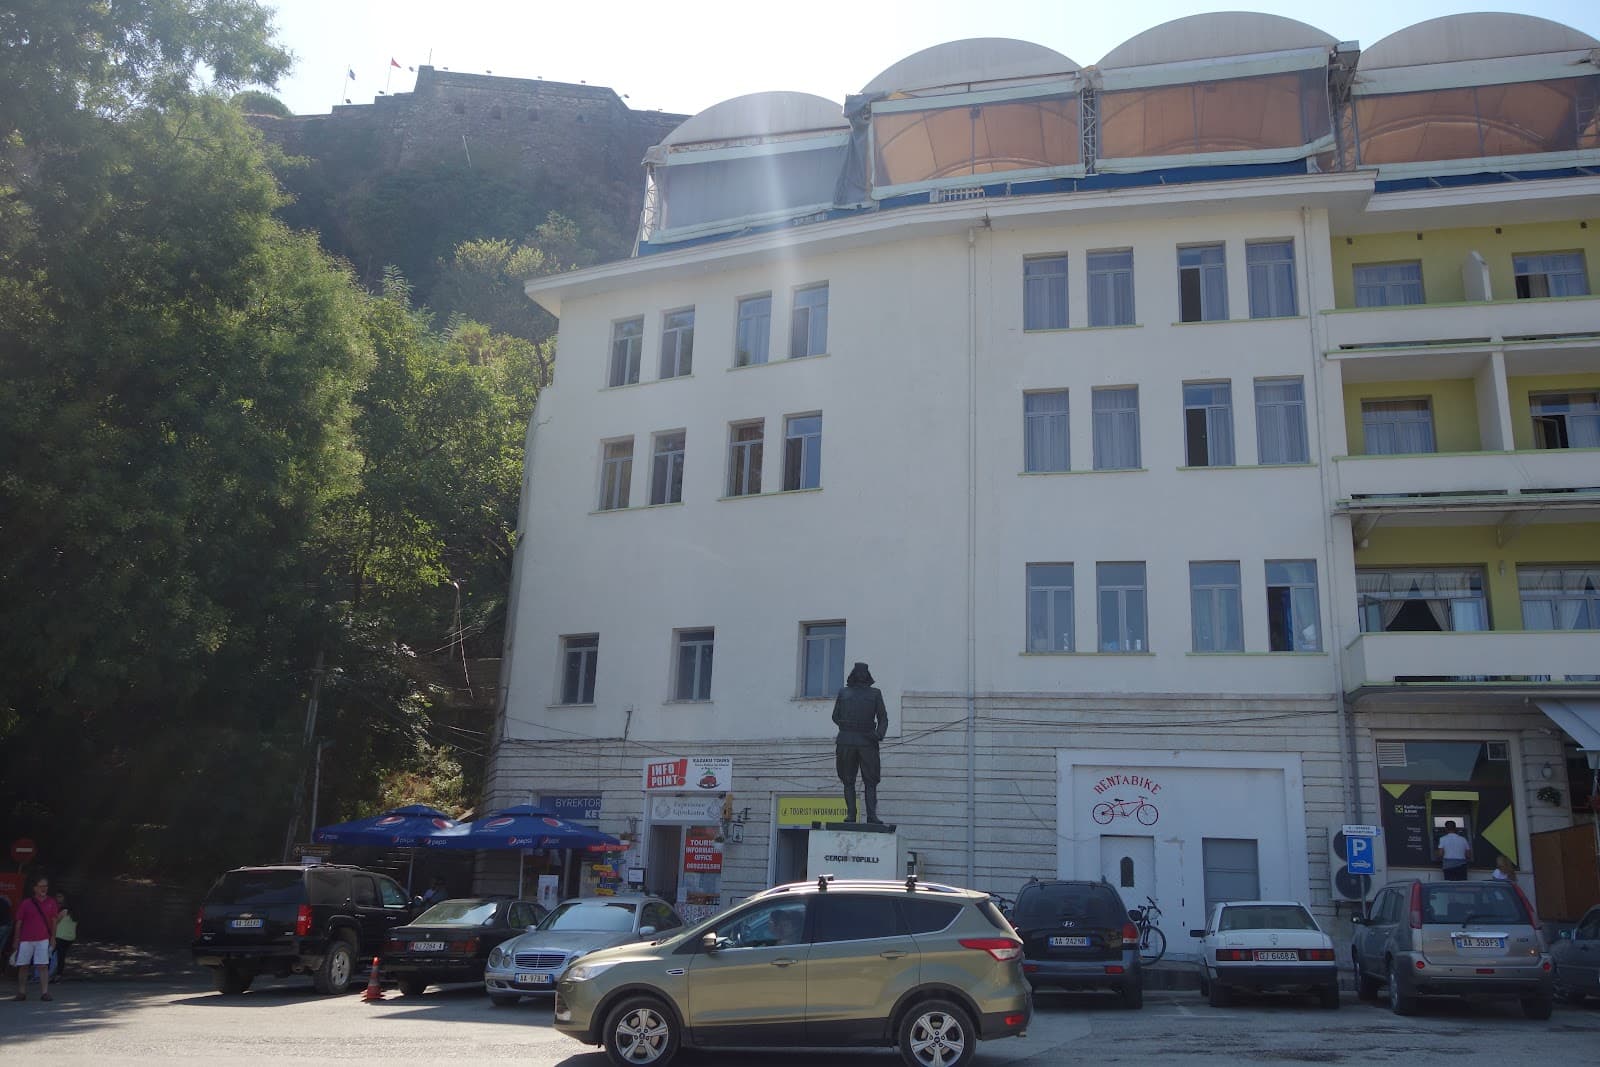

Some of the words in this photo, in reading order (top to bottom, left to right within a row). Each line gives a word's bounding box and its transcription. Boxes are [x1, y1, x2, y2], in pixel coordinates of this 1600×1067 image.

[651, 763, 675, 776] INFO
[790, 807, 812, 817] TOURIST
[1353, 839, 1367, 856] P
[1055, 937, 1063, 945] AA
[1463, 938, 1473, 947] AA
